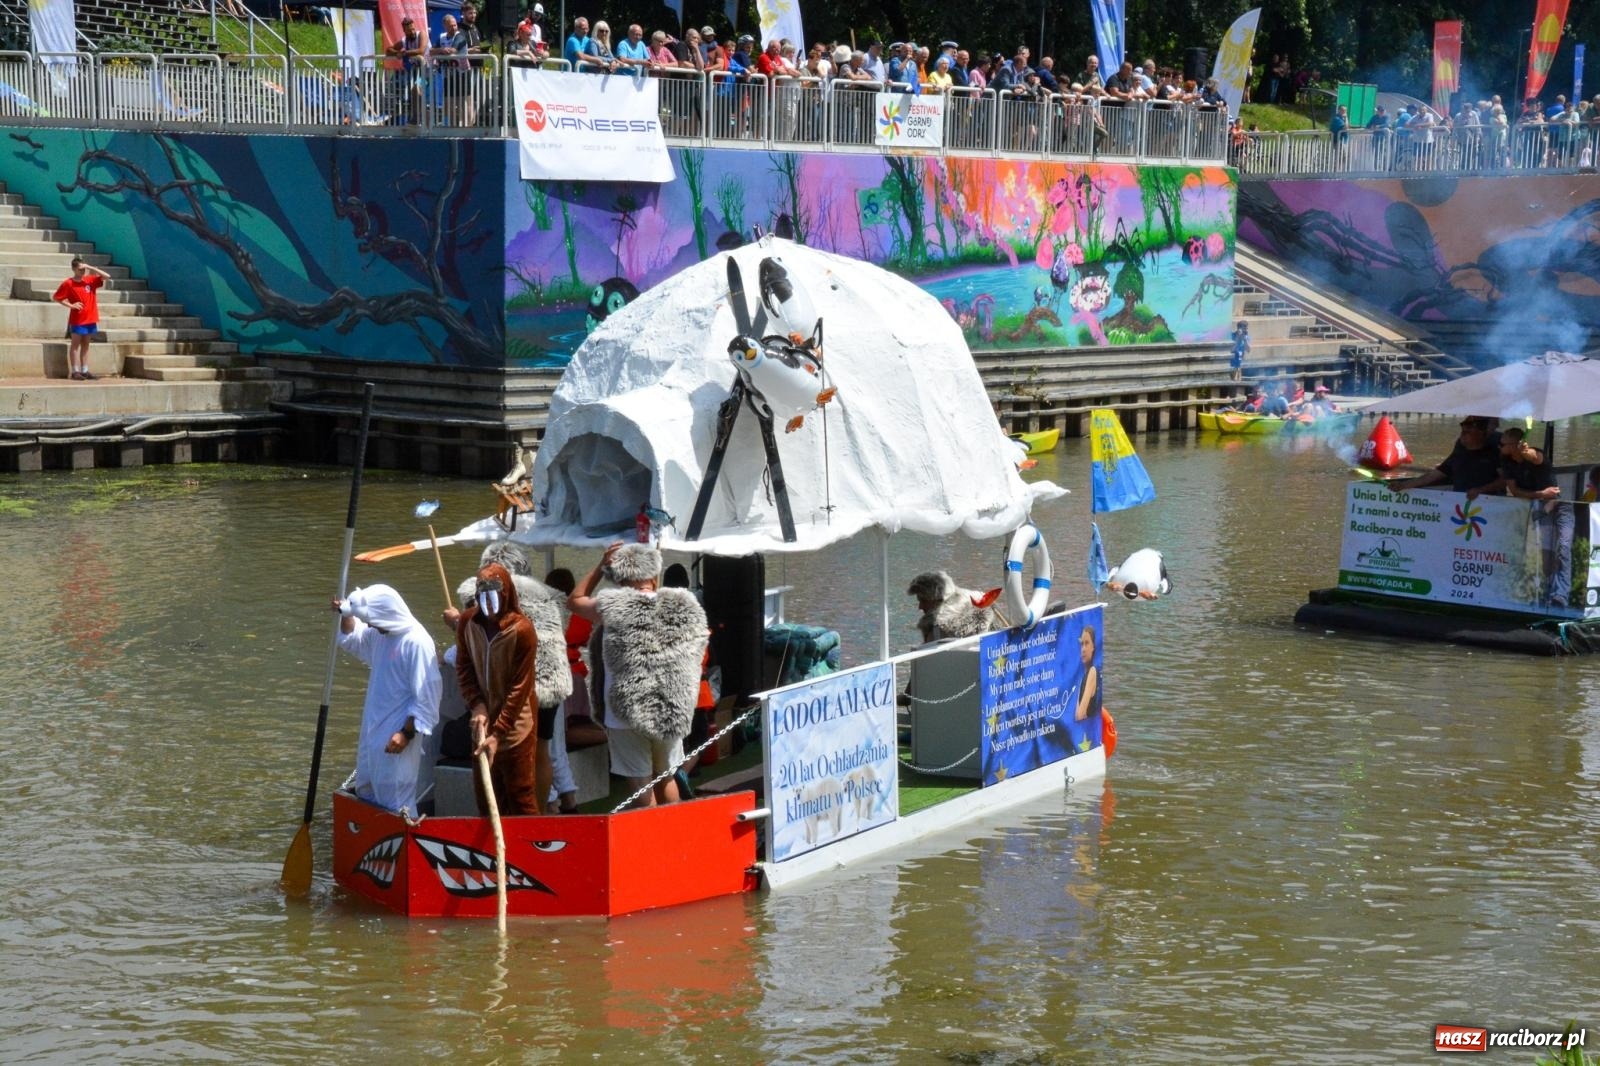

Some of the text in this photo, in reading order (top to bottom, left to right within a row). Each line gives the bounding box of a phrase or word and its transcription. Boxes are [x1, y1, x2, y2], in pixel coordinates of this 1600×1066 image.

[547, 104, 588, 114] RADIO
[908, 104, 941, 116] FESTIWAL
[548, 115, 657, 132] VANESSA
[907, 128, 926, 138] ODRY
[1352, 488, 1439, 508] Unia lat 20 ma...
[1357, 507, 1364, 515] z
[1365, 507, 1390, 517] nami
[1392, 511, 1399, 519] o
[1401, 511, 1441, 523] czystość
[1350, 520, 1426, 539] Raciborza dba
[1453, 547, 1509, 564] FESTIWAL
[1452, 573, 1484, 588] ODRY
[1450, 589, 1474, 599] 2024
[779, 763, 797, 790] 20
[799, 759, 815, 782] lat
[785, 776, 883, 824] klimatu w Polsce
